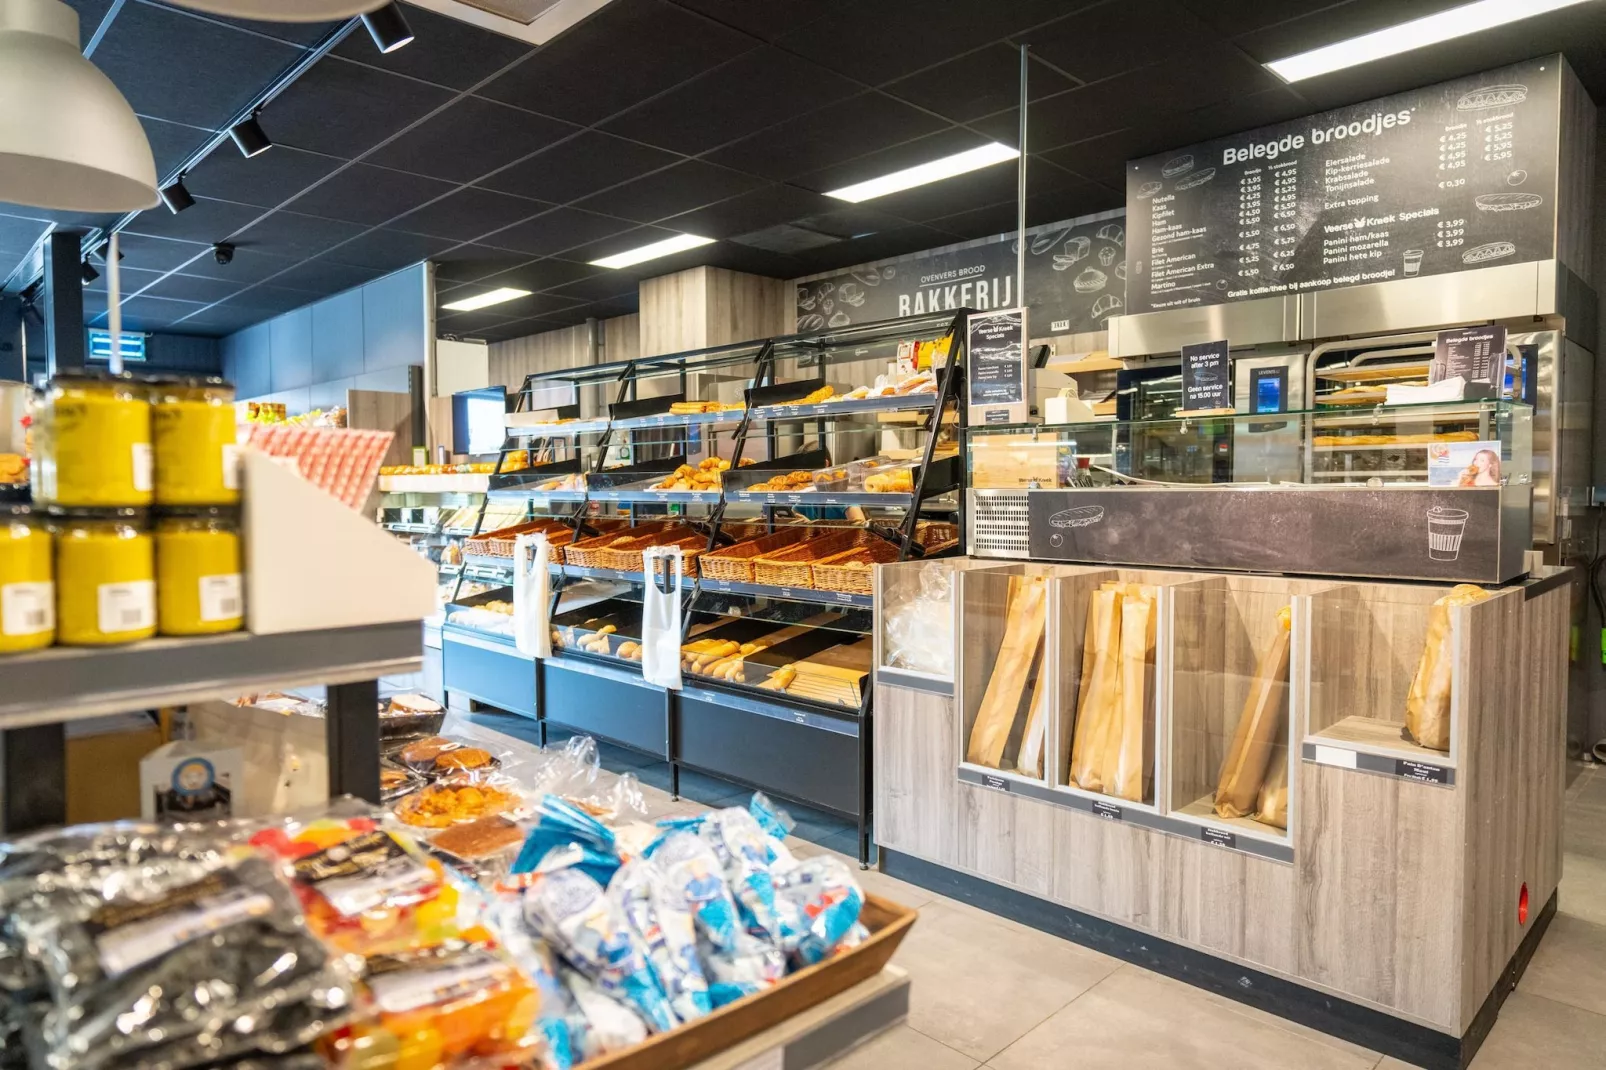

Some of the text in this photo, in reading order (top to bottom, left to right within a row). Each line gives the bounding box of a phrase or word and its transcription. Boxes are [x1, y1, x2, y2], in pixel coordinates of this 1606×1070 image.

[1223, 134, 1304, 165] Belegde
[1326, 153, 1366, 167] Eiersalade
[1326, 157, 1390, 176] Kip-kerriesalade
[1326, 170, 1369, 184] Krabsalade
[1326, 177, 1375, 192] Tonijnsalade
[1152, 194, 1175, 204] Nutella
[1325, 195, 1379, 210] Extra topping
[1152, 204, 1167, 212] Kaas
[1152, 209, 1175, 220] Kipfilet
[1324, 223, 1354, 234] Veerse
[1399, 208, 1440, 221] Specials
[1152, 224, 1182, 234] Ham-kaas
[1152, 232, 1175, 242] Gezond
[1176, 227, 1207, 237] ham-kaas
[1324, 231, 1390, 247] Panini ham/kaas
[1324, 240, 1389, 256] Panini mozarella
[1166, 254, 1196, 264] American
[1324, 250, 1382, 264] Panini hete kip
[921, 265, 986, 284] OVENVERS BROOD
[1166, 266, 1195, 276] American
[1197, 263, 1214, 271] Extra
[1151, 282, 1176, 290] Martino
[1228, 269, 1396, 298] Gratis koffie/thee bij aankoop belegd broodje!
[899, 276, 1011, 317] BAKKERIJ
[1199, 352, 1220, 361] service
